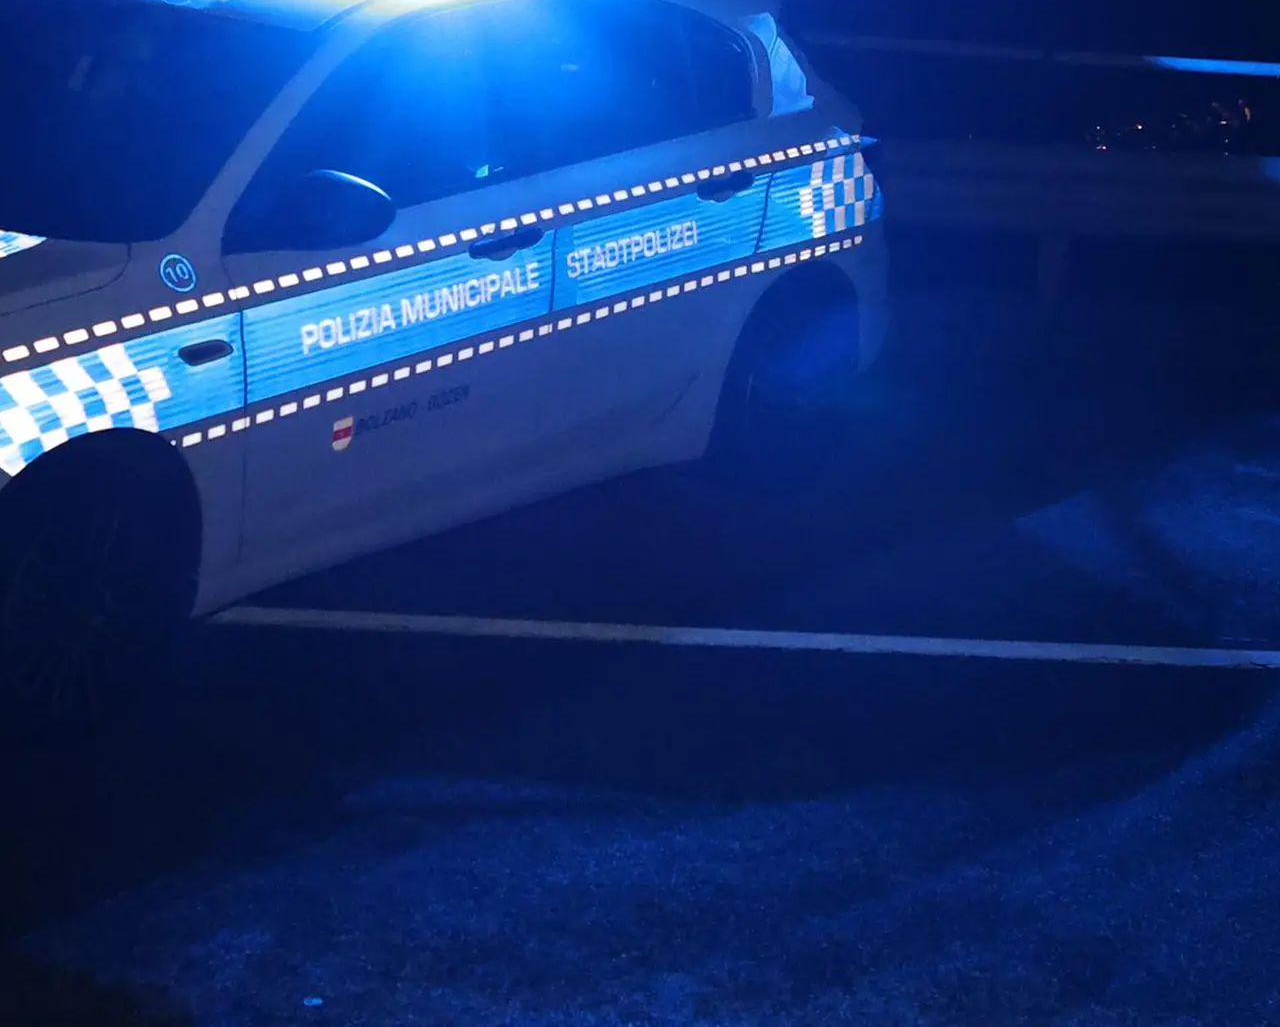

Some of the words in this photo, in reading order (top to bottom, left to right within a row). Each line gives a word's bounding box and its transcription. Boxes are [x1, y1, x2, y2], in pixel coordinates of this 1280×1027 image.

[566, 220, 698, 278] STADTPOLIZEI
[300, 302, 397, 355] POLIZIA
[400, 261, 540, 327] MUNICIPALE
